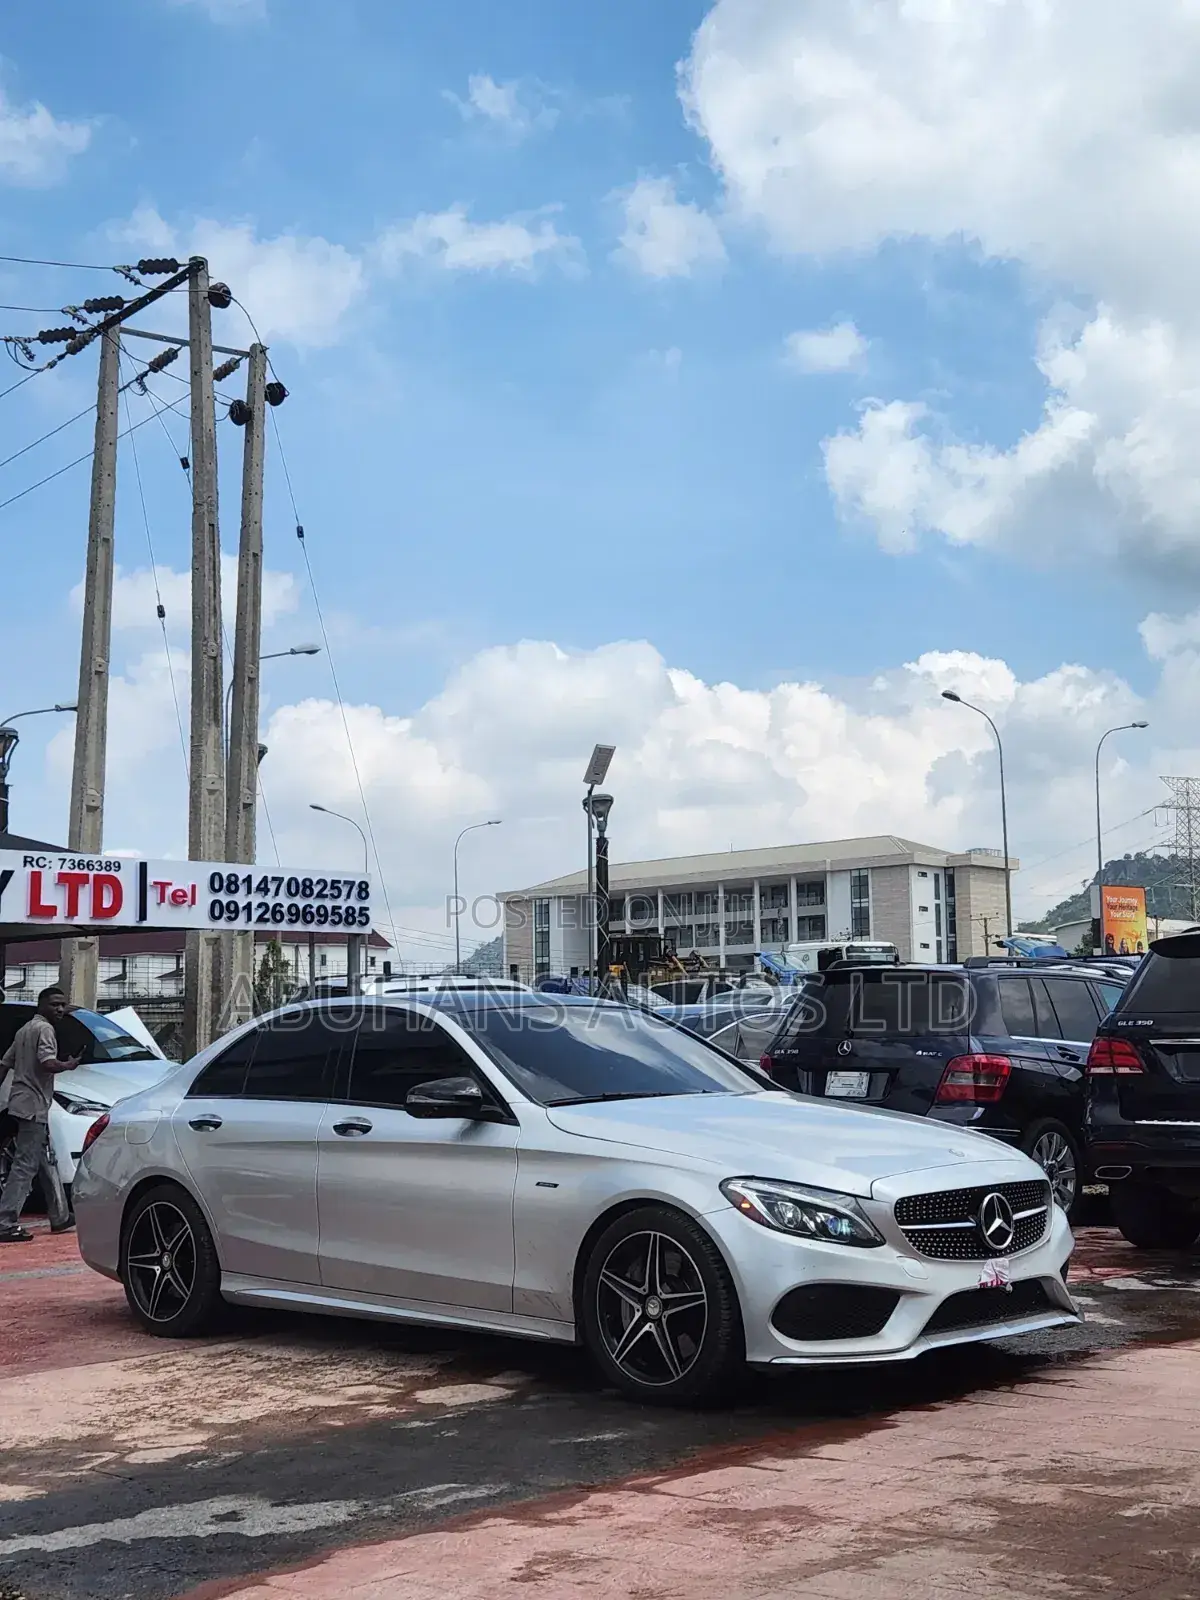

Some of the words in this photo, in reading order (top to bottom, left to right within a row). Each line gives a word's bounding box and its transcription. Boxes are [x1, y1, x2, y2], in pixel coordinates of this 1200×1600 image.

[23, 855, 52, 870] RC:
[58, 857, 121, 873] 7366389
[28, 870, 123, 919] LTD
[152, 880, 197, 907] Tel
[208, 871, 370, 901] 08147082578
[208, 899, 370, 927] 09126969585
